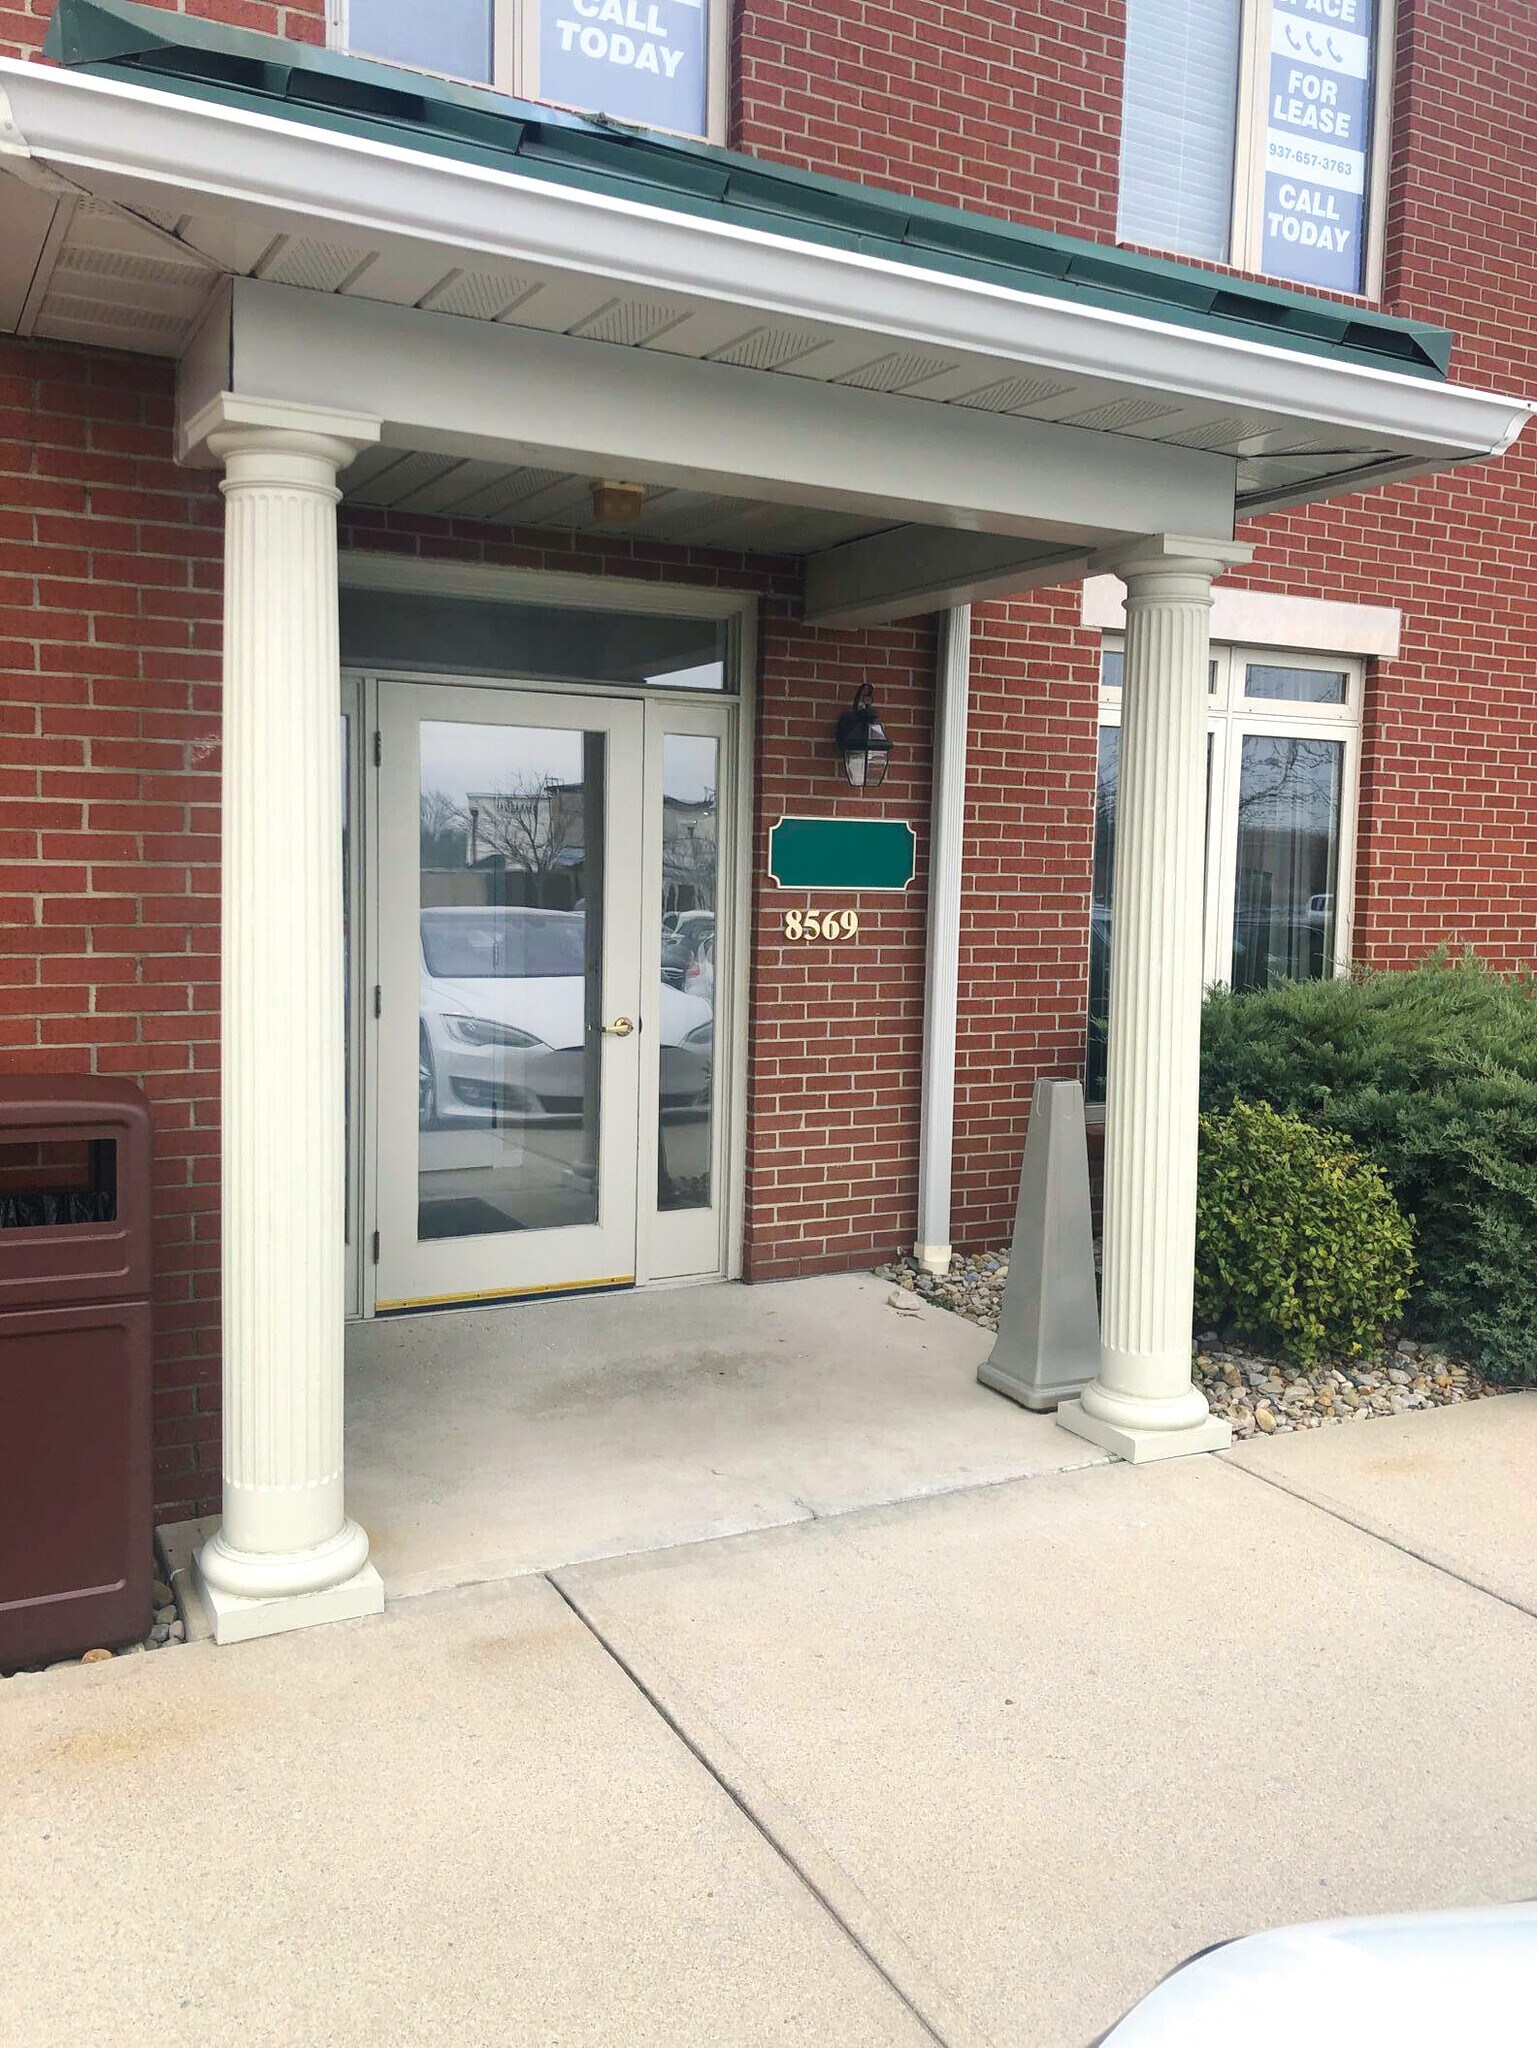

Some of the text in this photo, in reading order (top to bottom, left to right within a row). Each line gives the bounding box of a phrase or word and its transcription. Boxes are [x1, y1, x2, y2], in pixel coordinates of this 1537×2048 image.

[573, 0, 667, 37] CALL
[1279, 0, 1356, 22] ACE
[556, 19, 684, 78] TODAY
[1288, 69, 1338, 105] FOR
[1273, 95, 1351, 138] LEASE
[1279, 183, 1340, 221] CALL
[1268, 212, 1350, 252] TODAY
[785, 909, 858, 940] 8569
